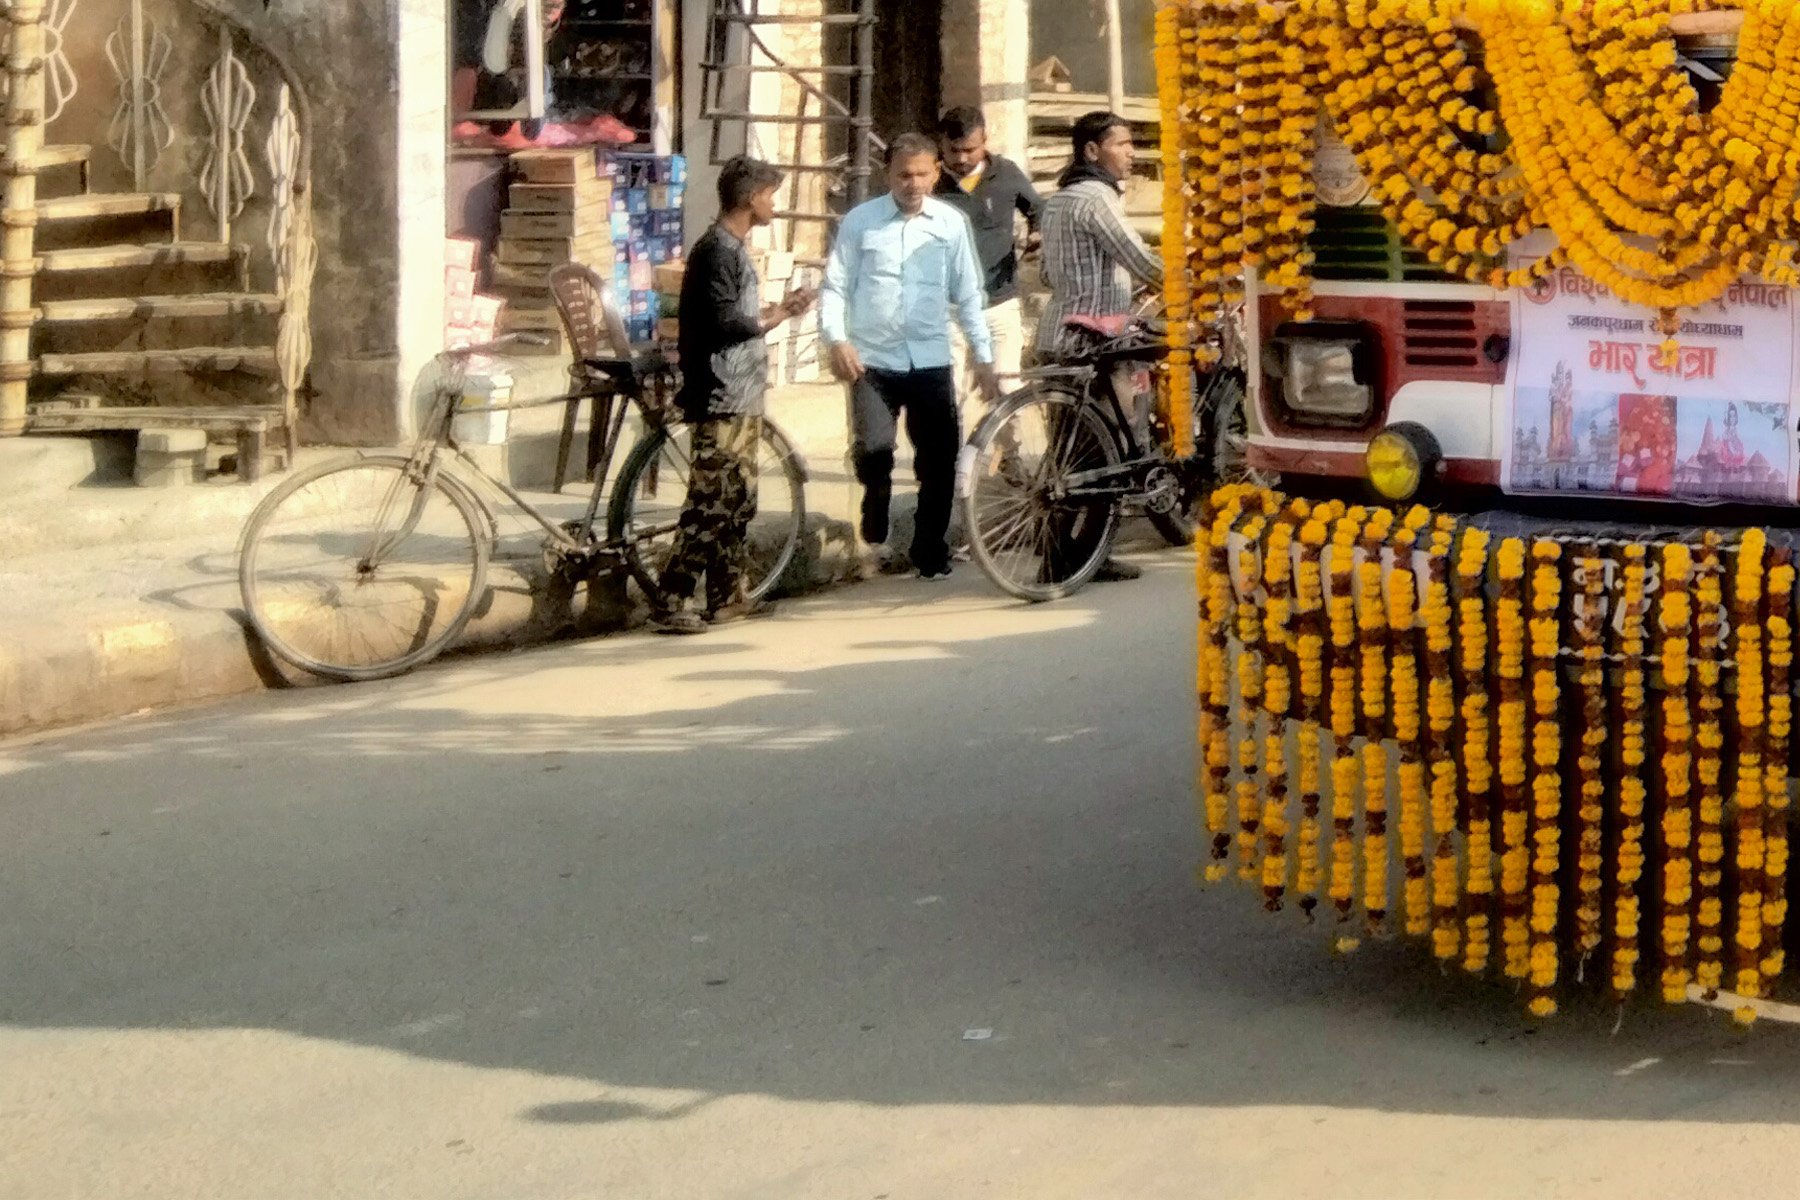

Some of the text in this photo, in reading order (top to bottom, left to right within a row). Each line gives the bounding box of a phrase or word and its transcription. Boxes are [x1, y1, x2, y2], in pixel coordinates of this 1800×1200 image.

[1727, 277, 1790, 309] नेपाल
[1678, 317, 1744, 338] योध्याधाम
[1588, 339, 1720, 390] भार यात्रा
